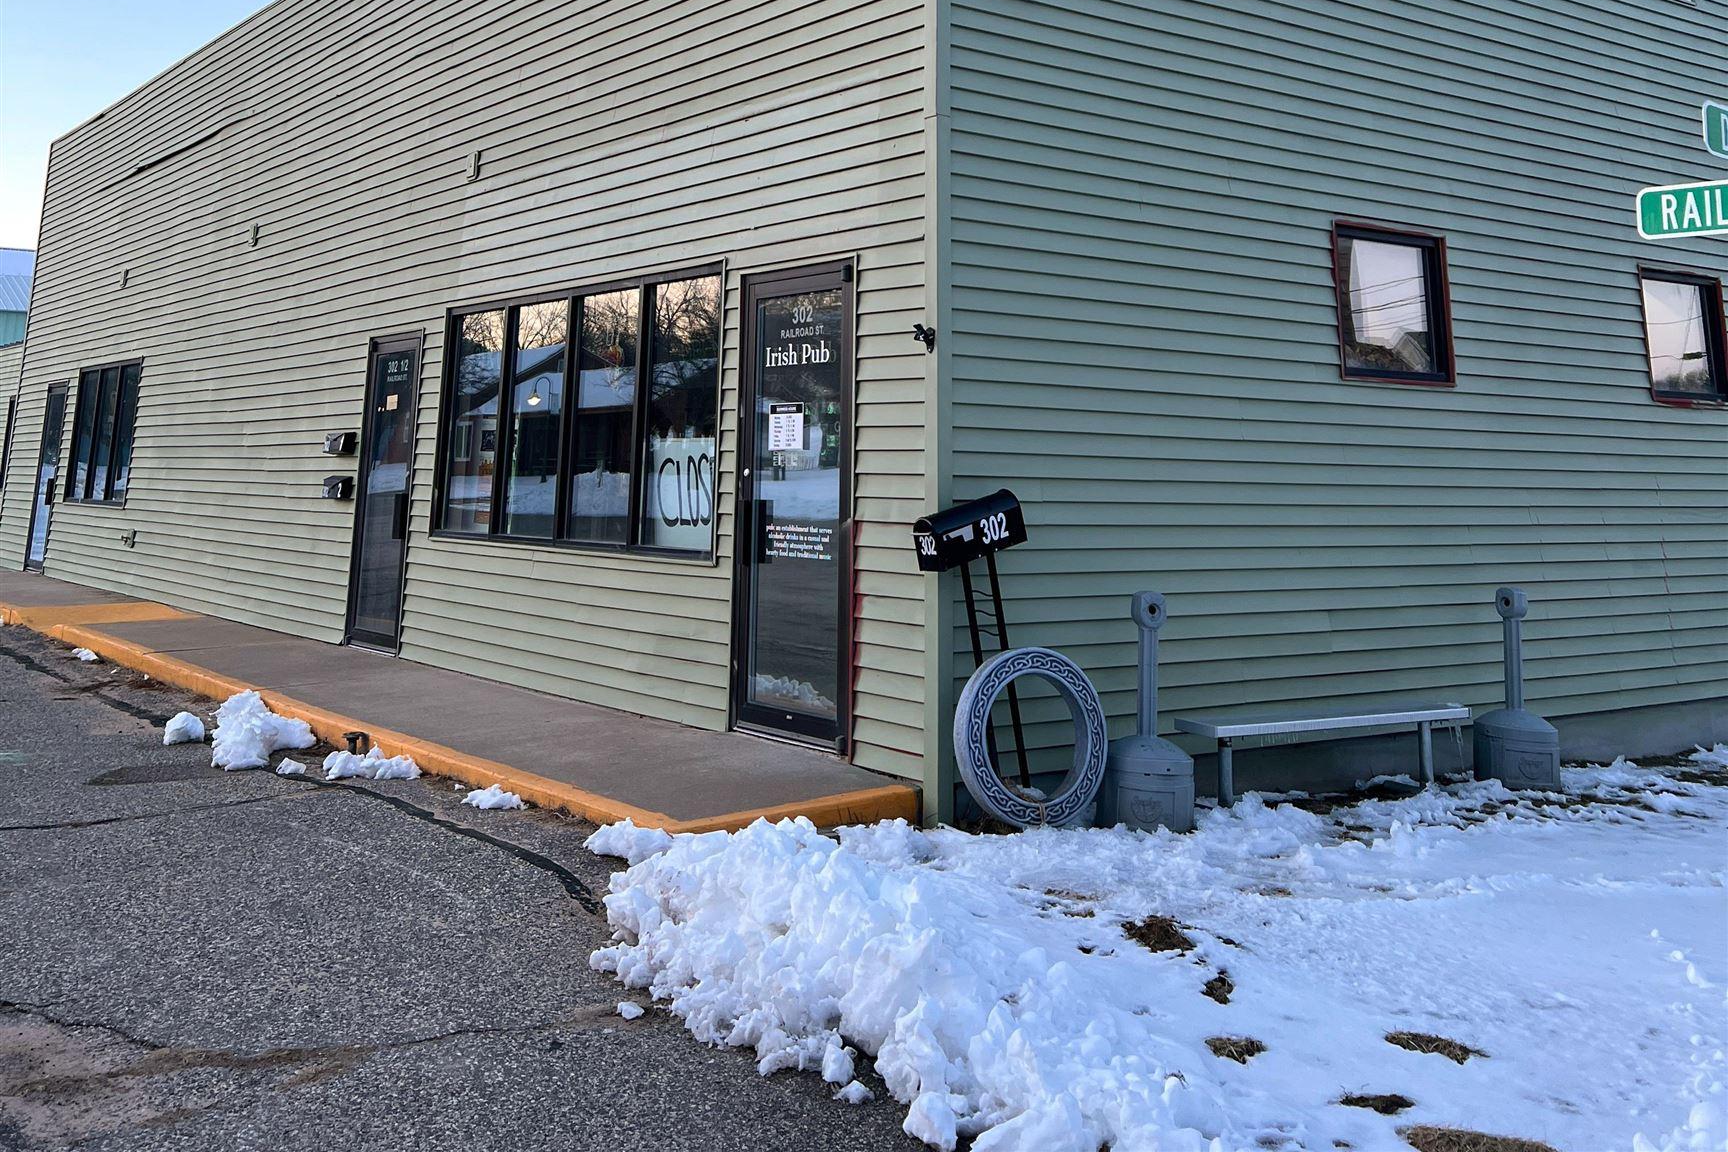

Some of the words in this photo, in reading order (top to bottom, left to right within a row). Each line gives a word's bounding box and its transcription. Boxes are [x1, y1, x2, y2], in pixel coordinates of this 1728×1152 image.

[1661, 188, 1728, 230] RAIL
[792, 305, 813, 324] 302
[780, 326, 814, 339] RAILROAD
[766, 343, 798, 367] Irish
[801, 340, 830, 364] Pub
[388, 360, 399, 373] 302
[980, 512, 1009, 545] 302
[920, 536, 937, 556] 302
